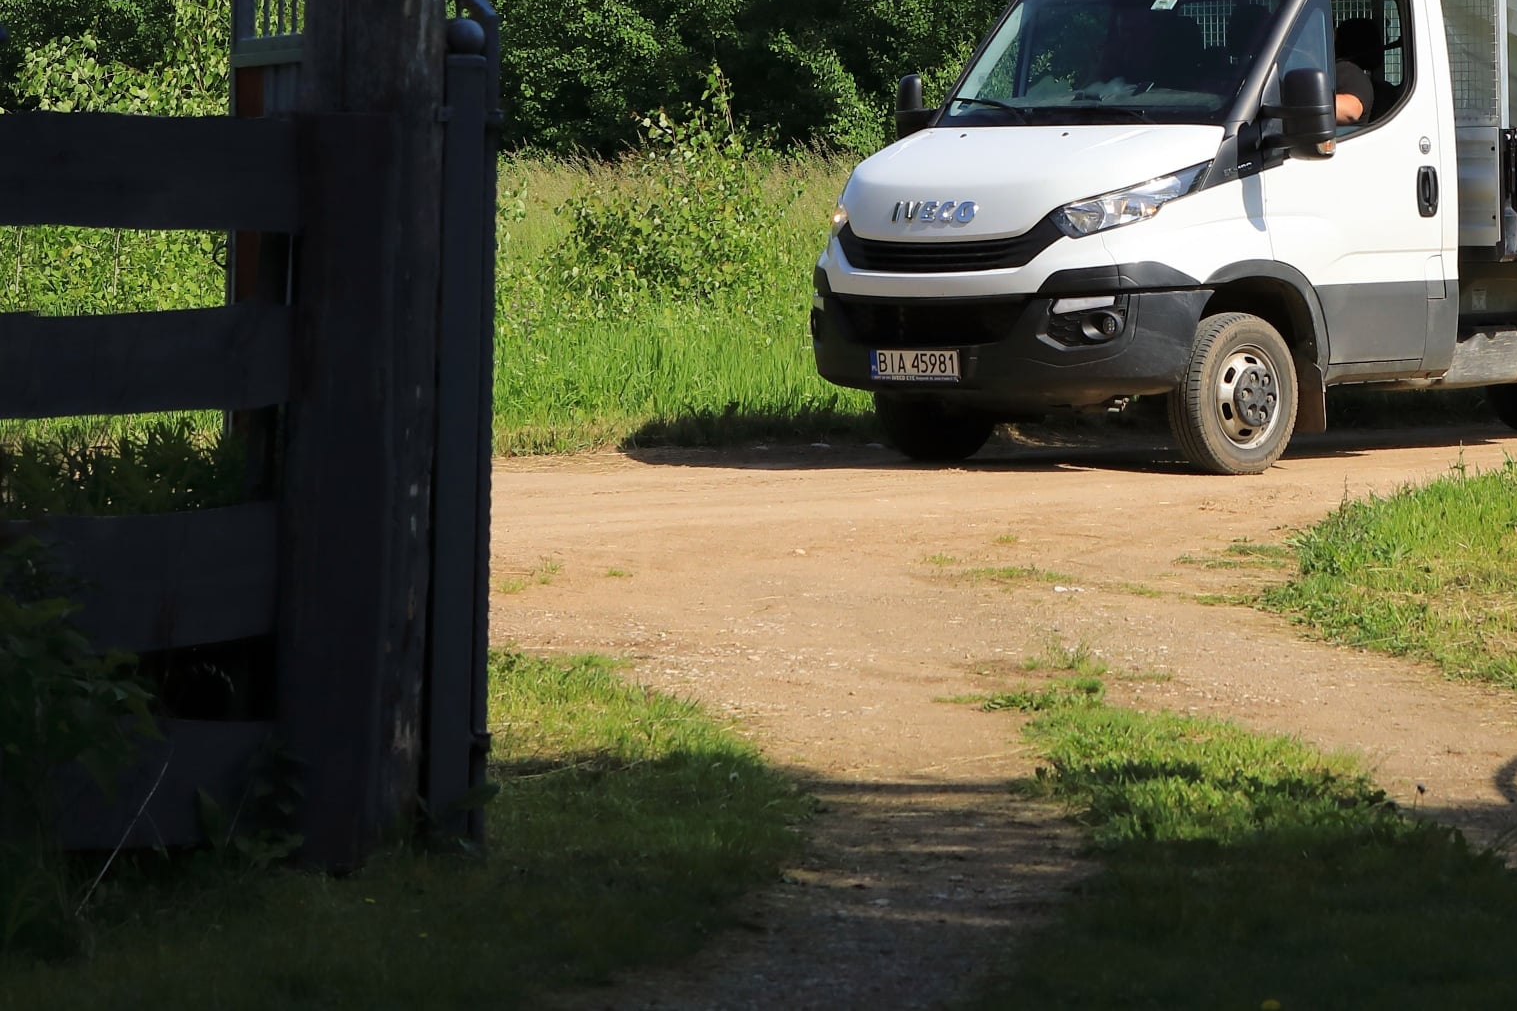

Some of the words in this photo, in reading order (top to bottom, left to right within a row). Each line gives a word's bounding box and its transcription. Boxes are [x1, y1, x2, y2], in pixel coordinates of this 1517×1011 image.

[892, 201, 979, 223] IVECO
[878, 352, 906, 373] BIA
[911, 353, 954, 374] 45981
